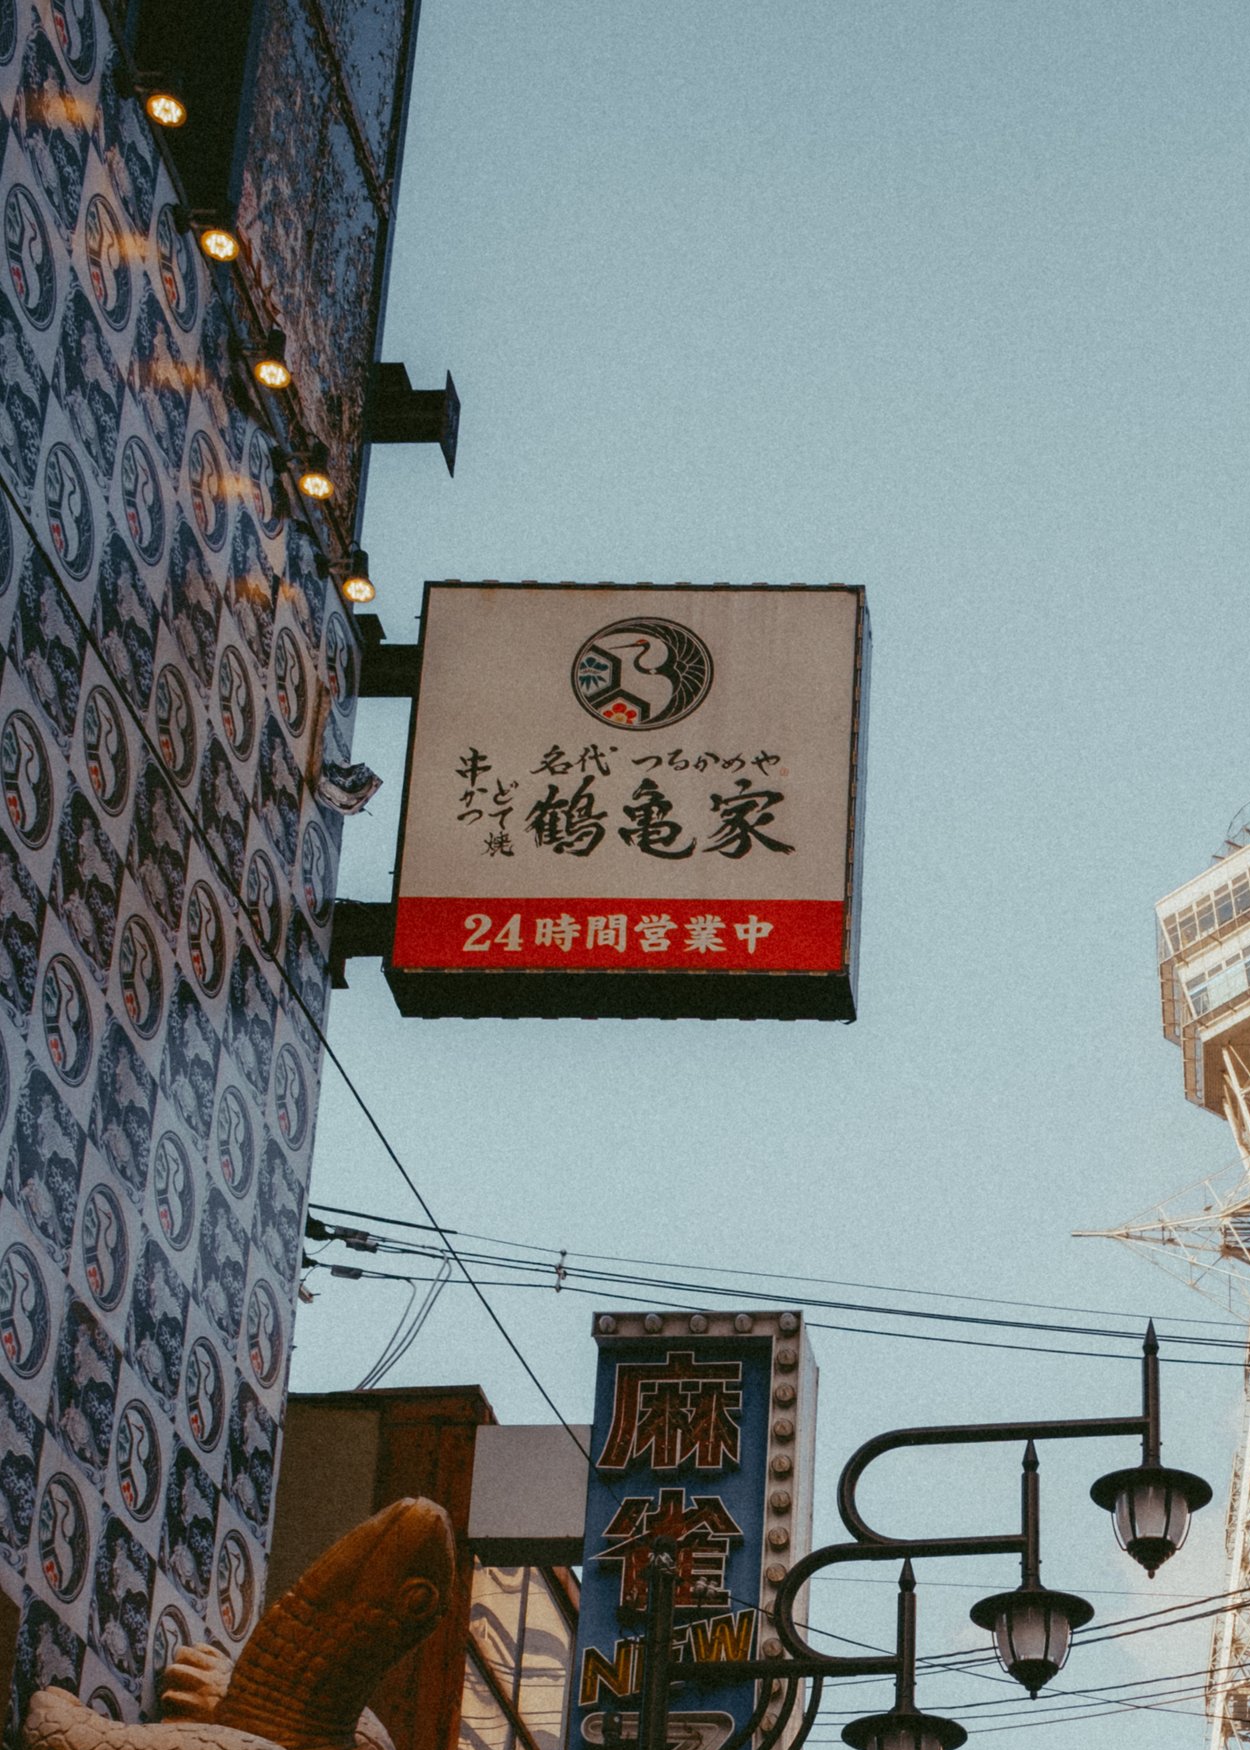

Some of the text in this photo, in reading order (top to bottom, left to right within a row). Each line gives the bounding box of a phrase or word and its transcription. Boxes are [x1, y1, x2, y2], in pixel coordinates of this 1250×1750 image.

[455, 746, 493, 826] 串かつ
[530, 744, 782, 777] 名代 つるかめや
[482, 778, 519, 858] どて焼
[524, 775, 797, 860] 鶴亀家
[462, 913, 776, 955] 24時間営業中
[588, 1350, 744, 1612] 麻雀
